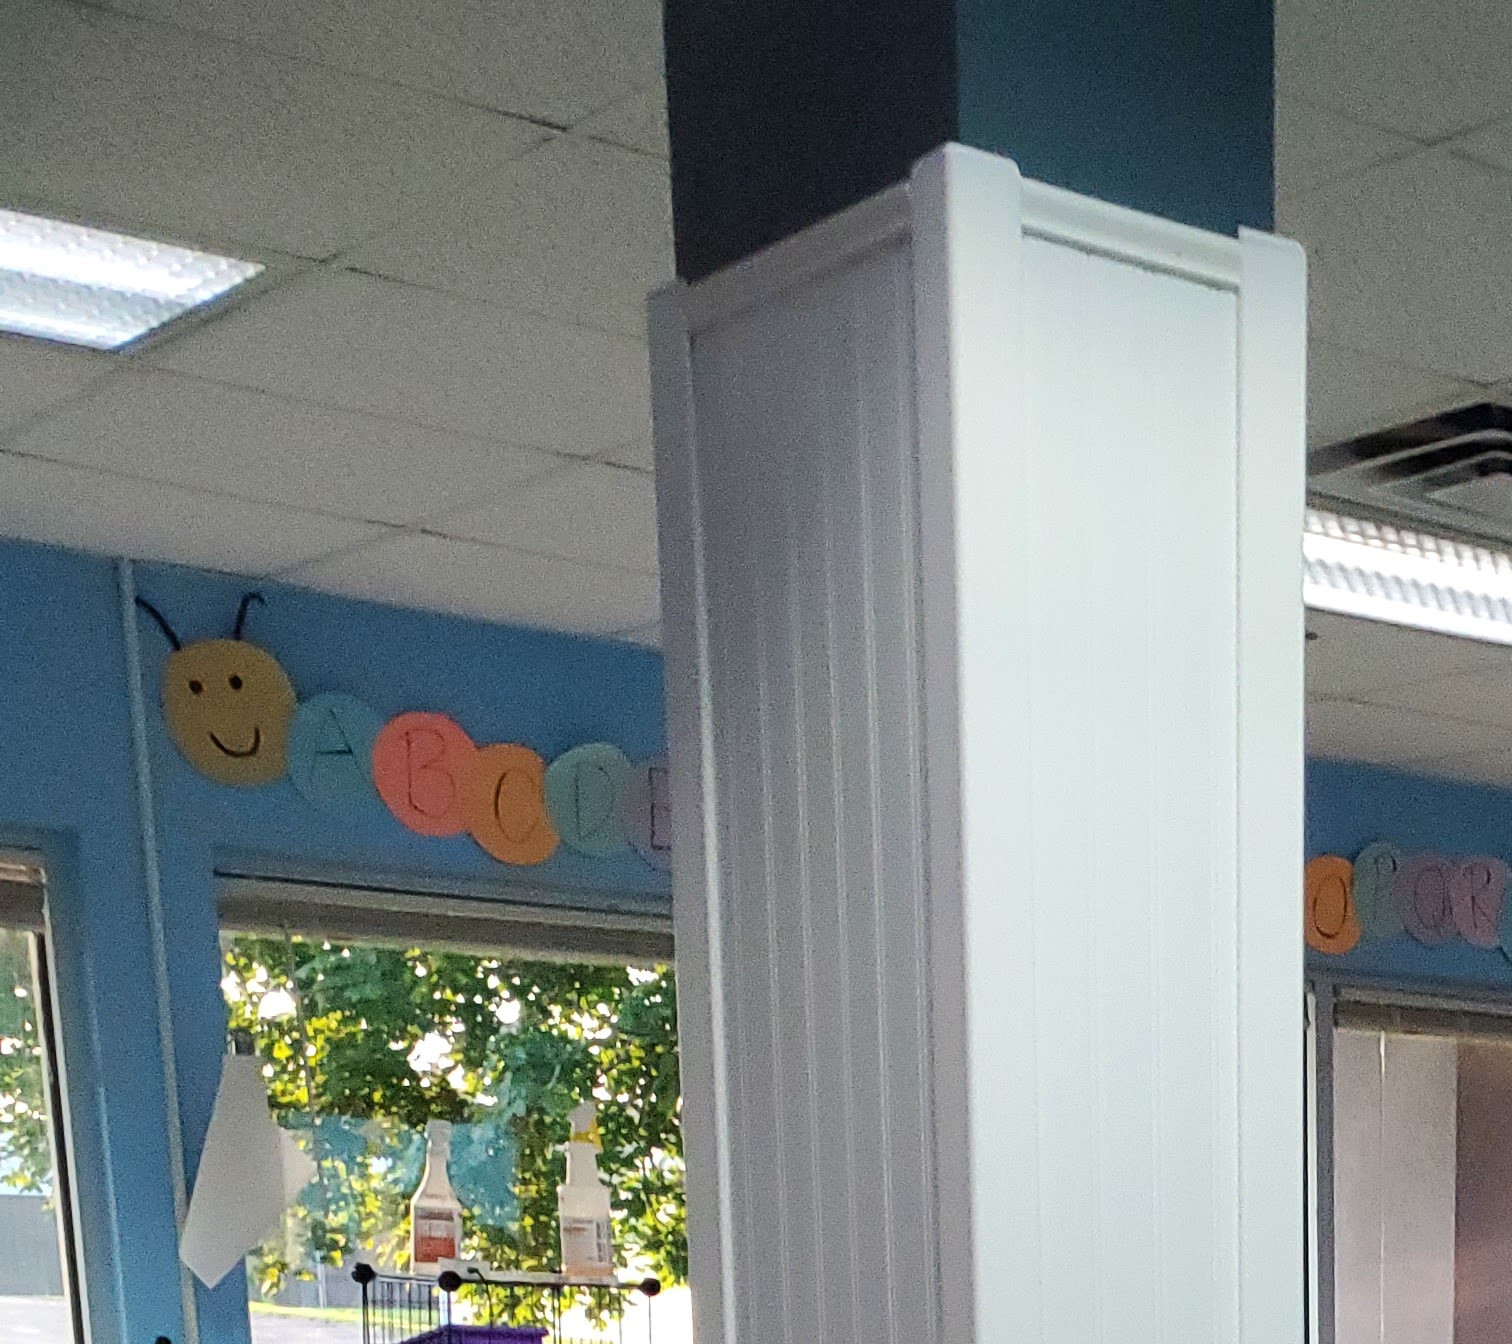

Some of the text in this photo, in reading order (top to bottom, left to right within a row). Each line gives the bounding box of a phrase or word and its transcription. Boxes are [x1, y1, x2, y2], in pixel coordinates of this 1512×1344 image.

[404, 726, 457, 819] B
[493, 768, 539, 845] C
[1311, 874, 1348, 940] O
